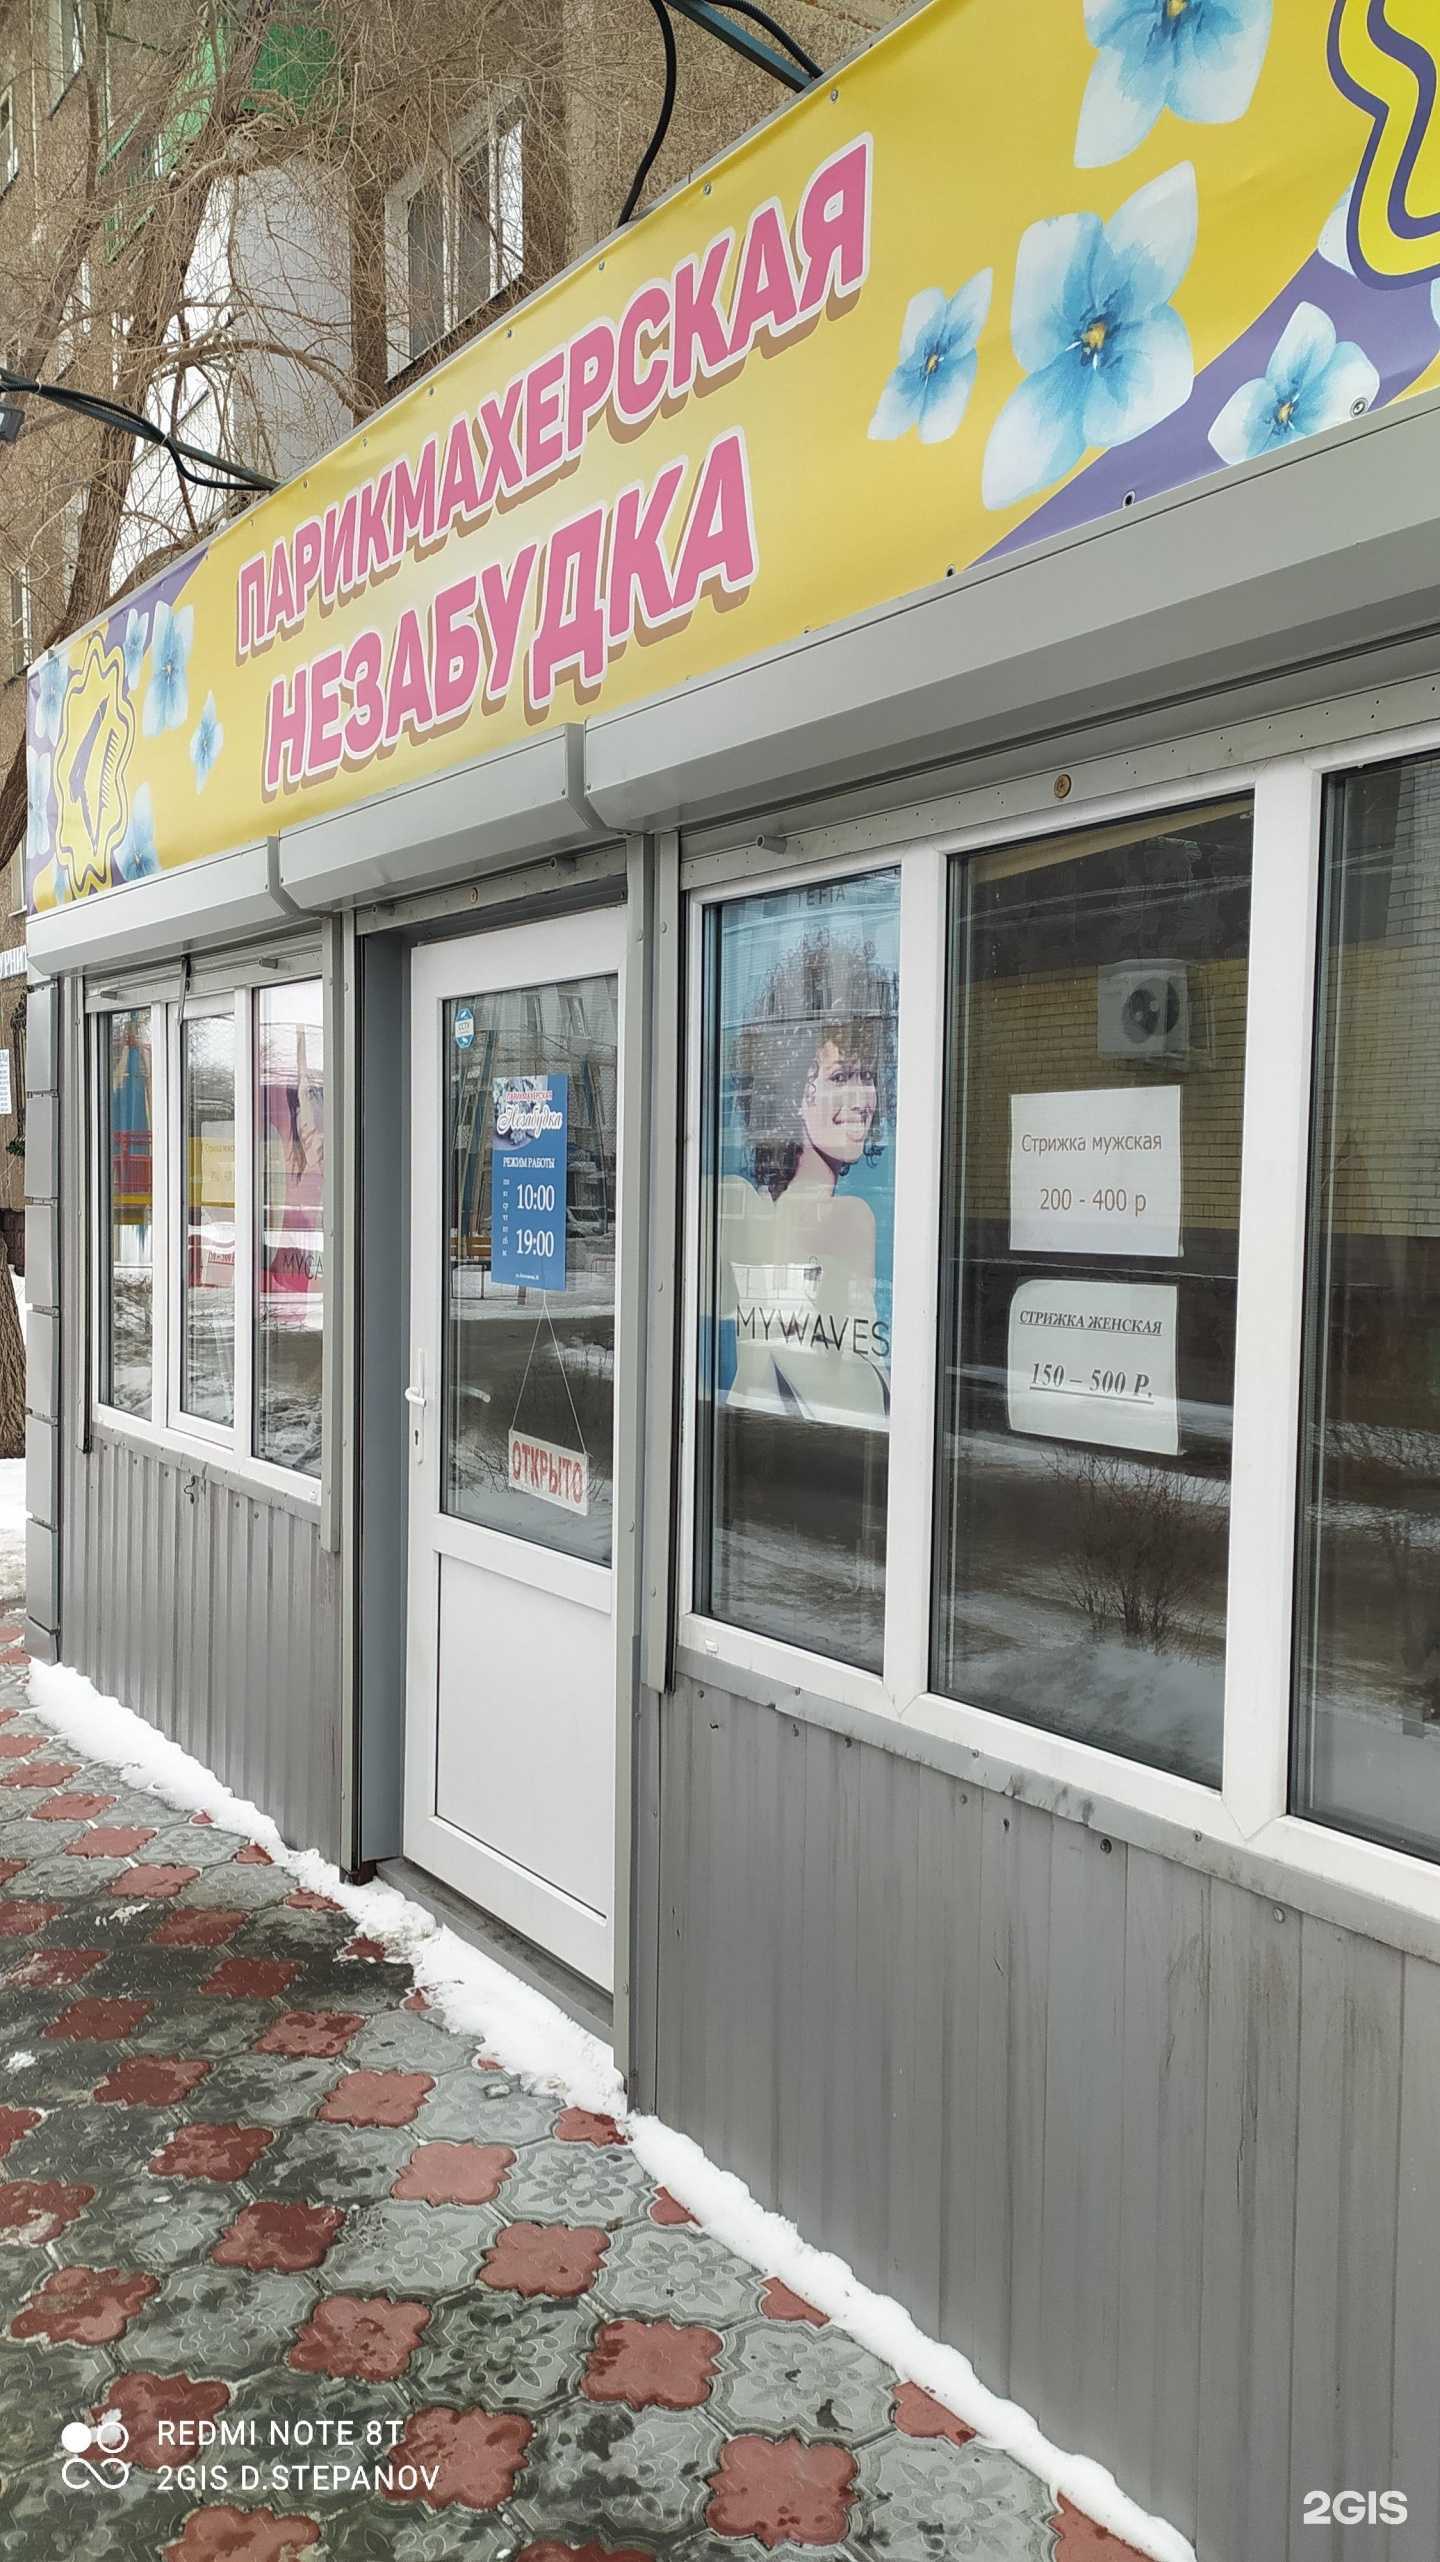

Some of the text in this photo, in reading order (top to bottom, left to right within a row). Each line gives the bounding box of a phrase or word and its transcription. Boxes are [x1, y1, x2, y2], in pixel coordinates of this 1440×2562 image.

[238, 138, 871, 660] ПАРИКМАХЕРСКАЯ
[263, 430, 757, 791] НЕЗАБУДКА
[1021, 1134, 1162, 1157] Стрижка мужская
[503, 1156, 556, 1169] РЕЖИМ РАБОТЫ
[517, 1184, 555, 1212] 10:00
[1040, 1188, 1072, 1210] 200
[1092, 1188, 1127, 1211] 400
[1135, 1193, 1147, 1217] р
[516, 1229, 554, 1257] 19:00
[736, 1303, 890, 1357] MYWAVES
[1019, 1310, 1162, 1335] СТРИЖКА ЖЕНСКАЯ
[1031, 1362, 1065, 1388] 150
[1089, 1369, 1126, 1394] 500
[1134, 1373, 1153, 1398] Р.
[512, 1440, 583, 1504] ОТКРЫТО
